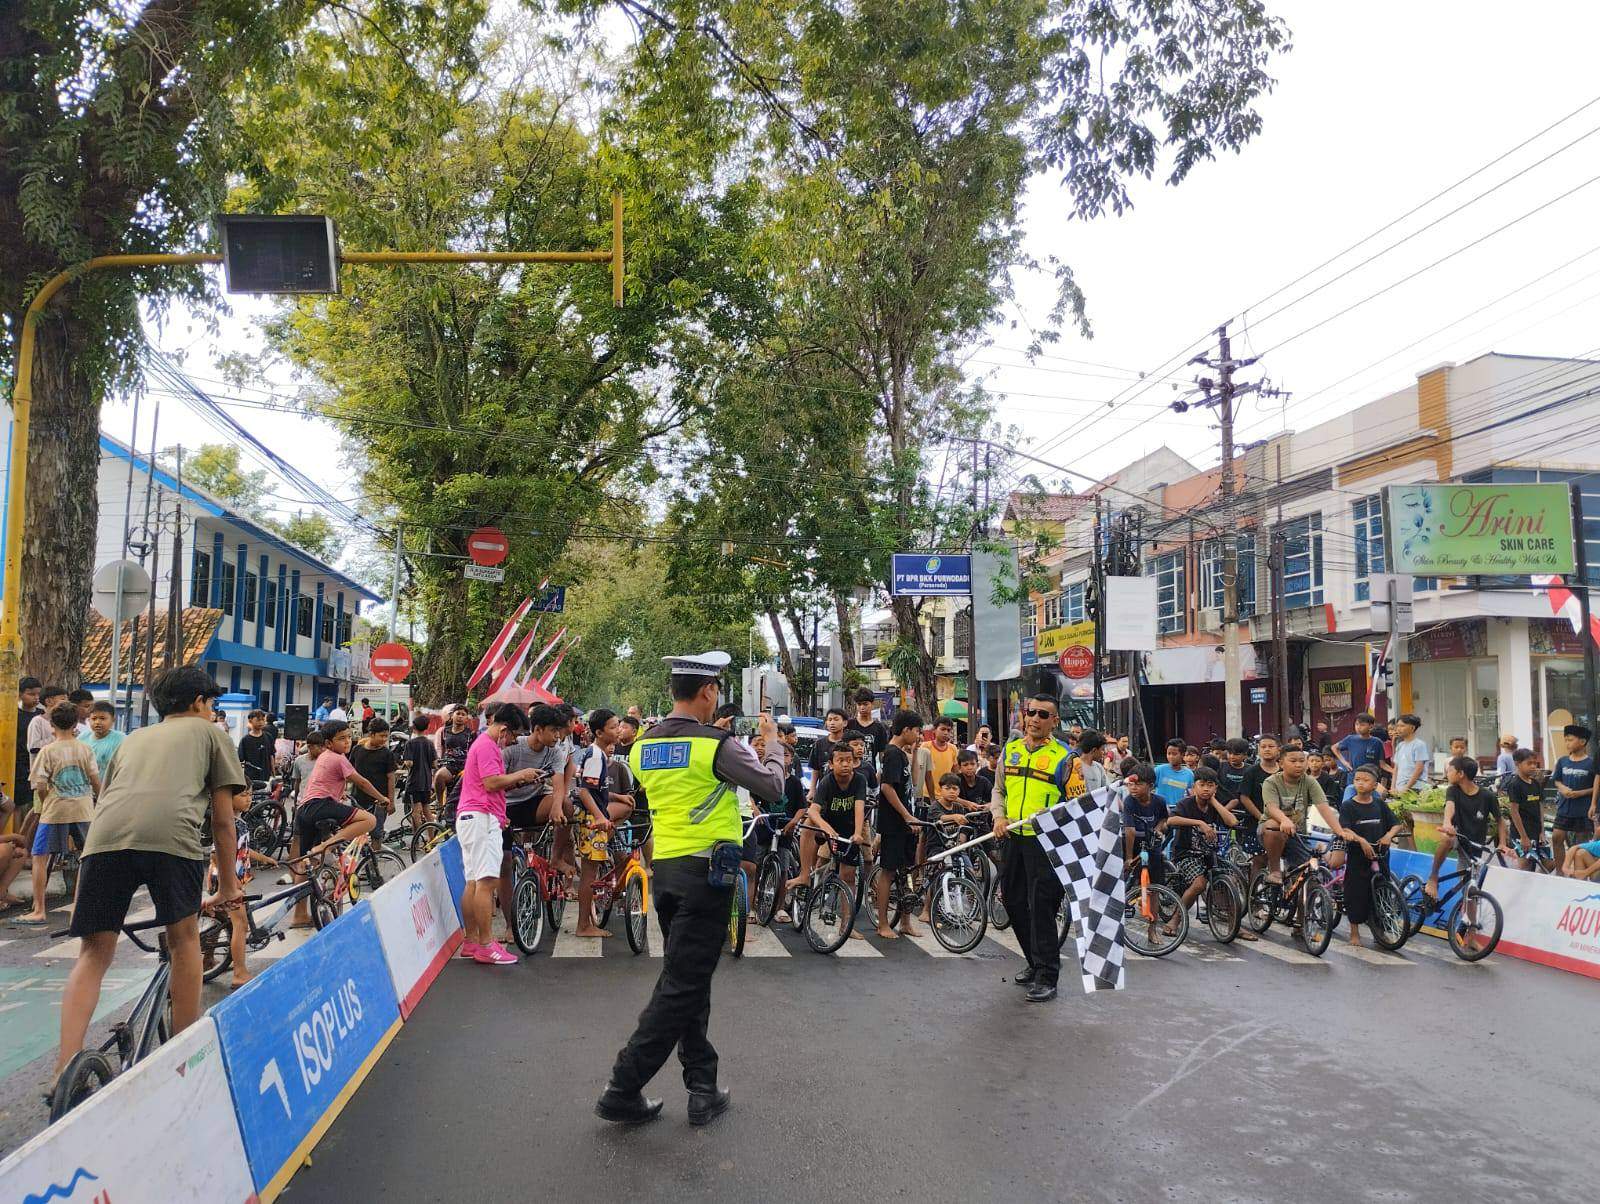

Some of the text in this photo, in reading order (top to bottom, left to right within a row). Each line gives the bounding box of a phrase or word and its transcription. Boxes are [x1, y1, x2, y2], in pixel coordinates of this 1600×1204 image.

[1439, 489, 1546, 538] Arini
[1500, 538, 1555, 551] SKIN CARE
[1413, 553, 1434, 566] Skin
[1437, 553, 1469, 567] Beauty
[1483, 552, 1517, 567] Healthy
[1519, 552, 1540, 566] With
[1542, 552, 1558, 566] Us
[896, 574, 904, 582] PT
[933, 574, 970, 582] PURWODADI
[1063, 657, 1089, 668] Happy
[643, 745, 688, 766] POLISI
[292, 978, 362, 1096] ISOPLUS
